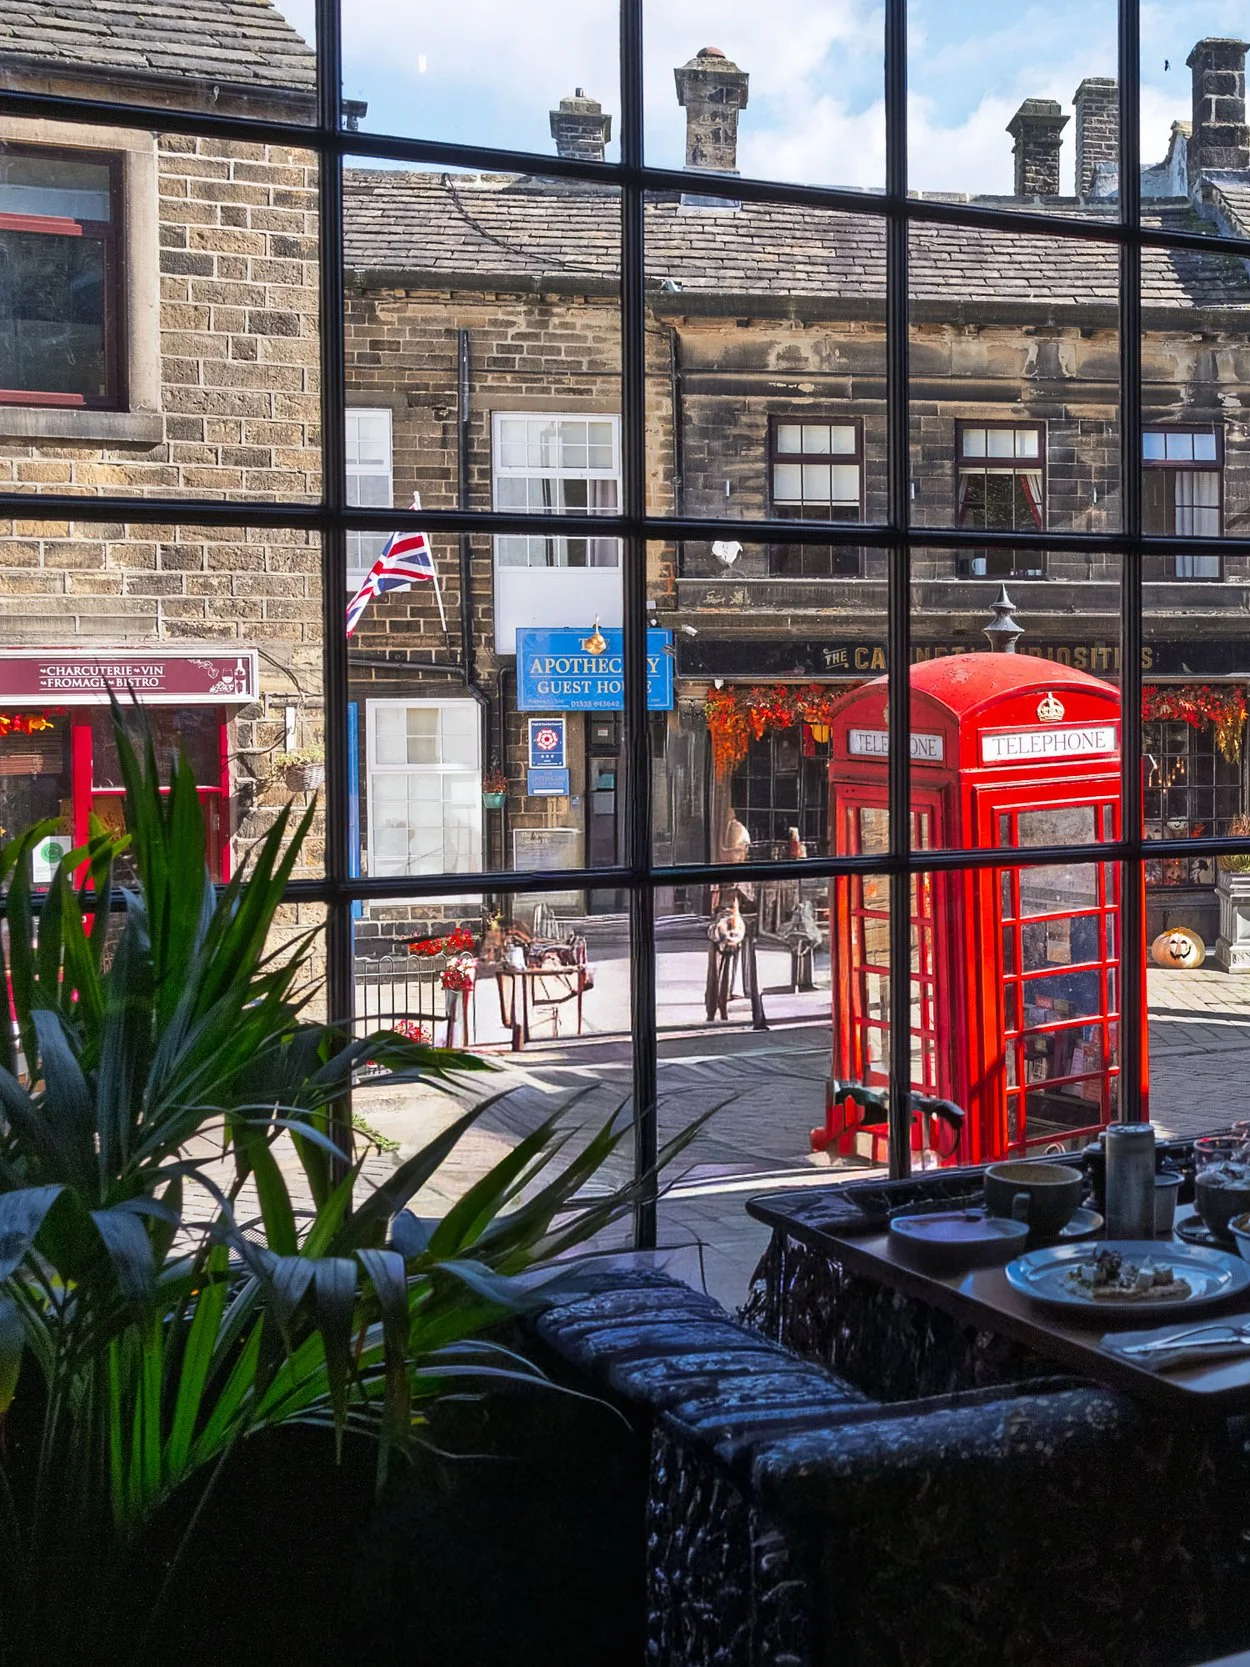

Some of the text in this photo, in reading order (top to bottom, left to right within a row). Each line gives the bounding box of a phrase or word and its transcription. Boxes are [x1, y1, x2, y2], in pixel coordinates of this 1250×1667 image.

[530, 657, 660, 674] APOTHECY
[825, 650, 847, 666] THE
[47, 666, 163, 676] CHARCUTERIE VIN
[47, 678, 159, 688] FROMAGE BISTRO
[537, 680, 652, 694] GUEST HOE
[857, 733, 937, 757] TELEONE
[992, 731, 1106, 756] TELEPHONE
